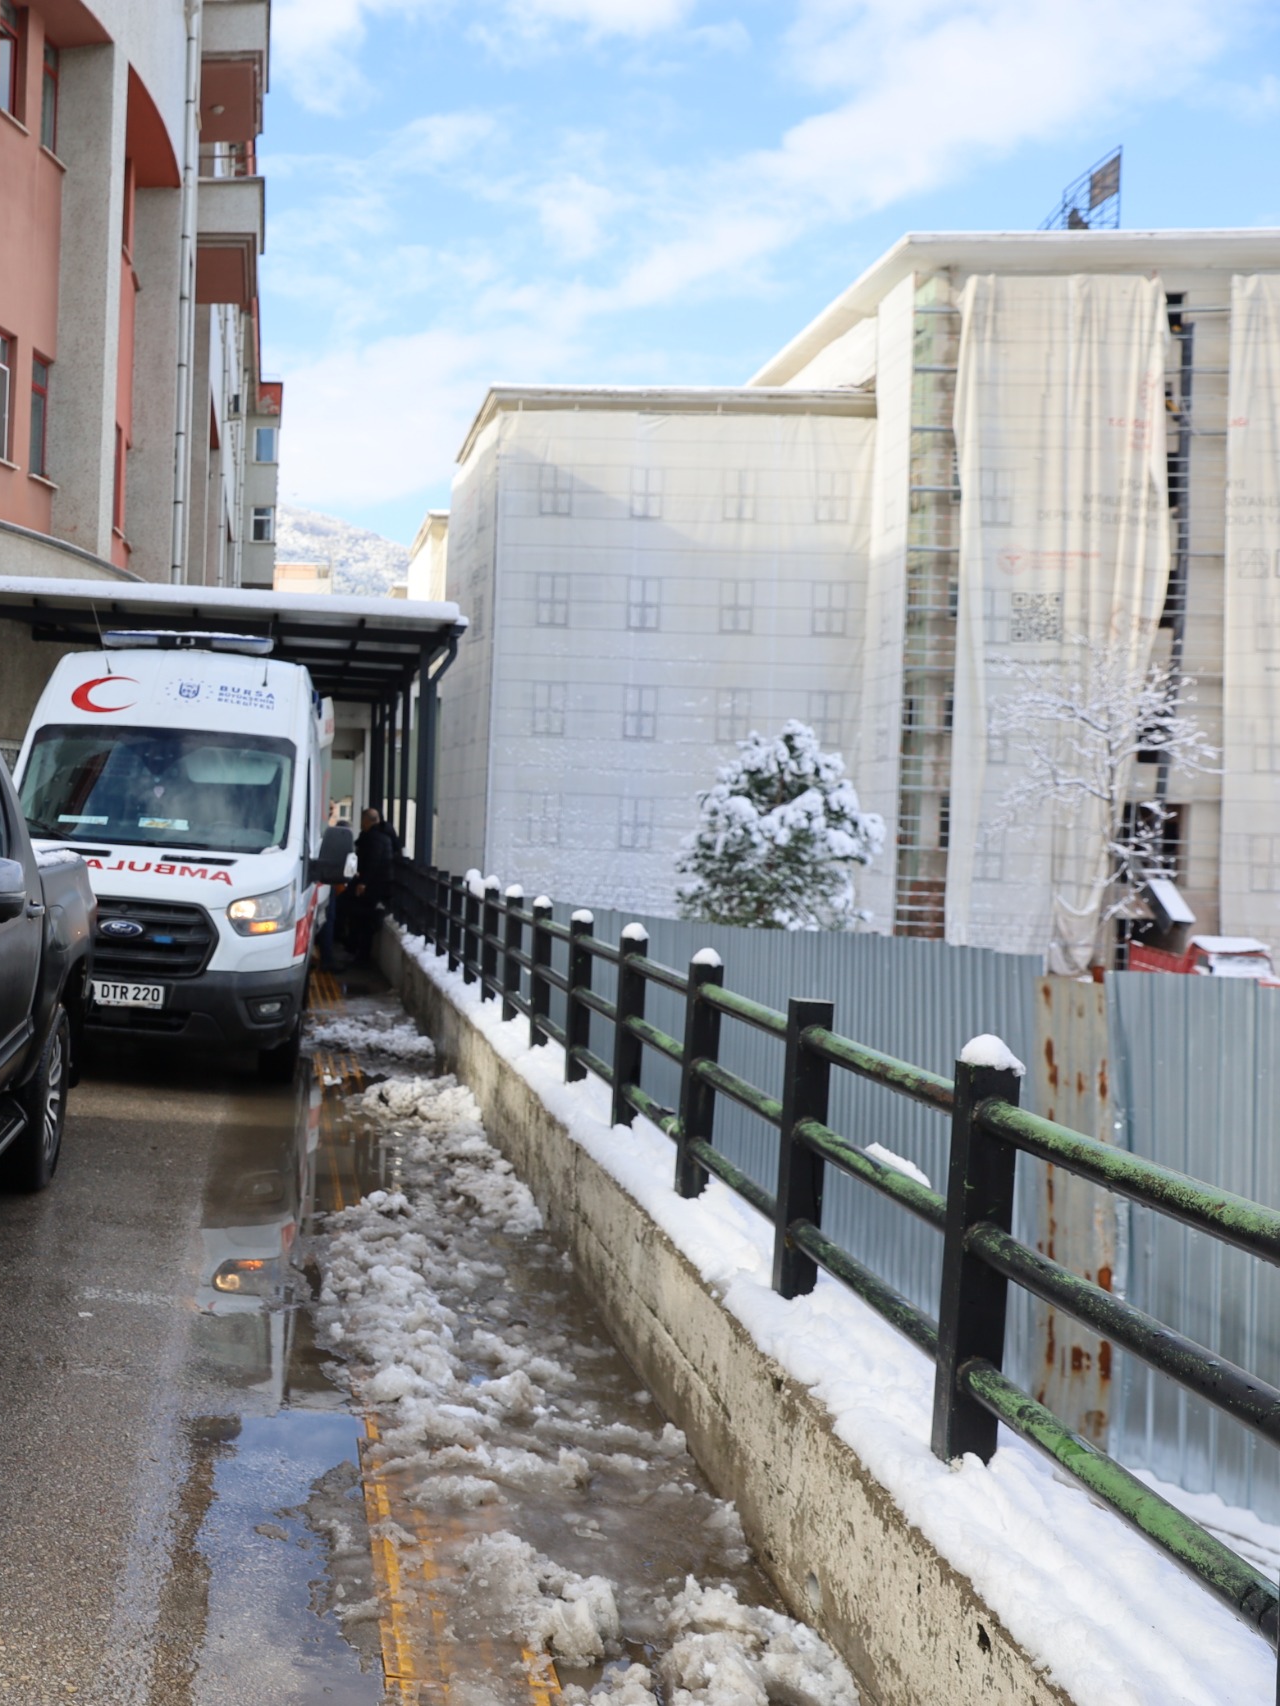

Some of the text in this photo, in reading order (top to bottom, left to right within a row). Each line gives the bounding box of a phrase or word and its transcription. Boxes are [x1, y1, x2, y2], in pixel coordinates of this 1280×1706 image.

[220, 685, 275, 700] BURSA
[101, 984, 160, 1002] DTR 220
